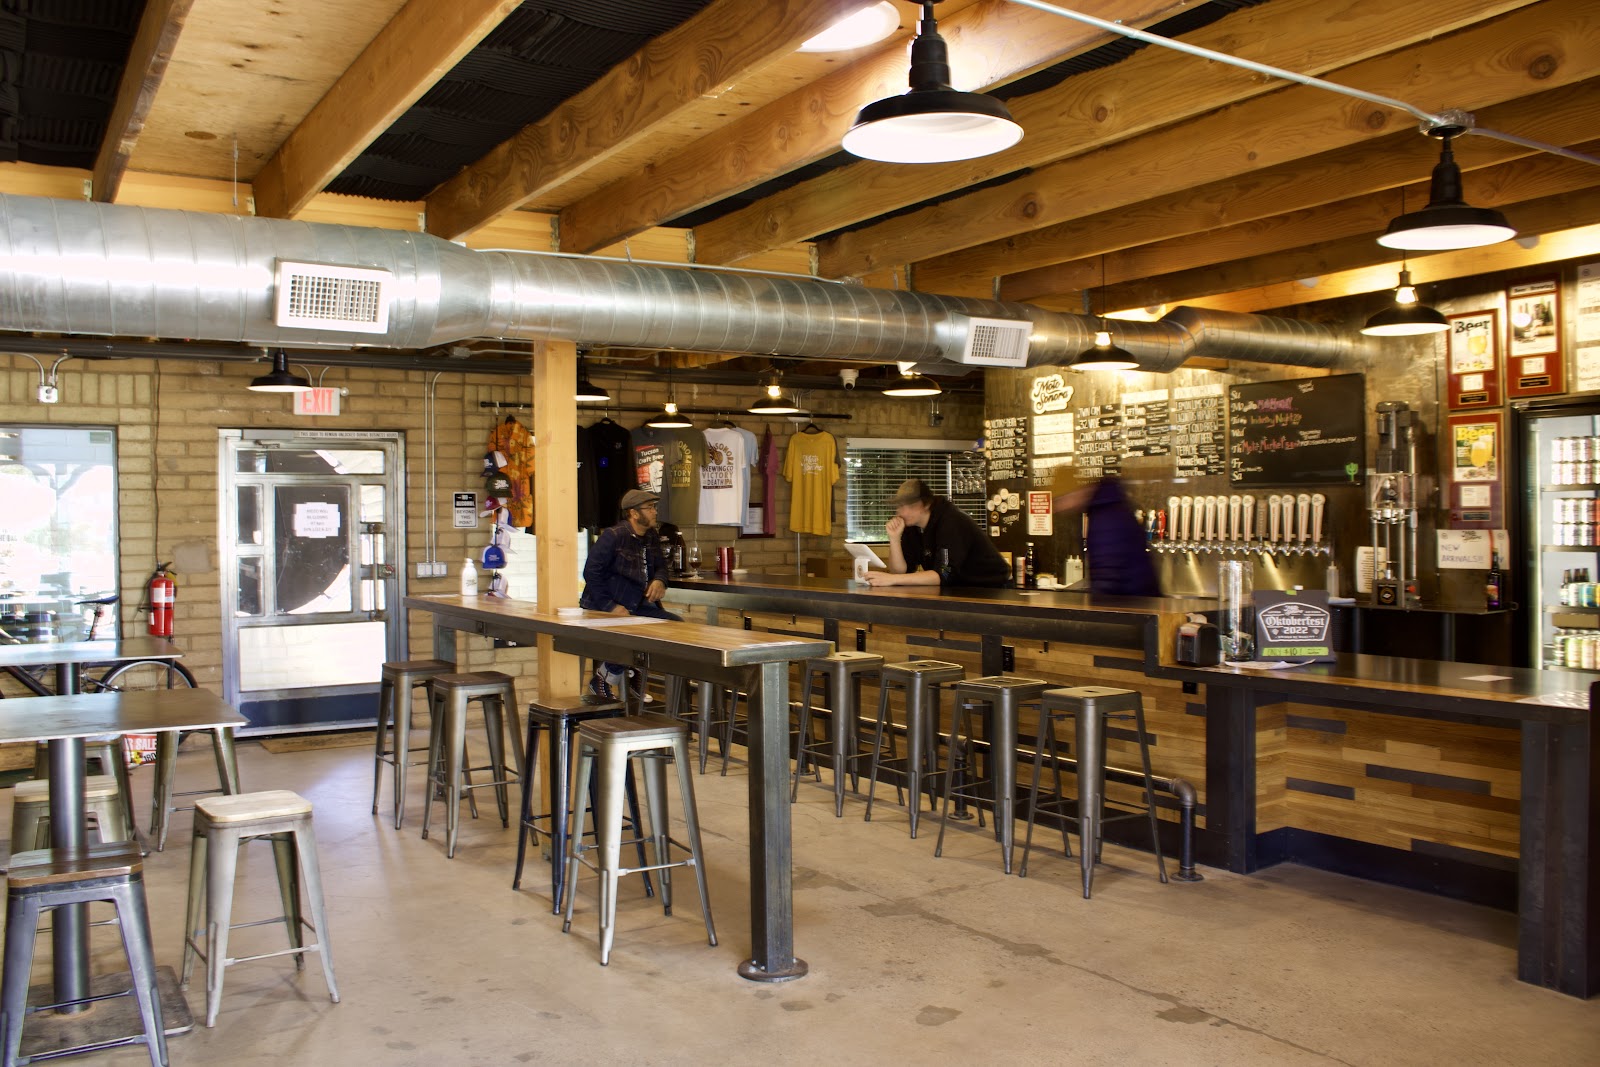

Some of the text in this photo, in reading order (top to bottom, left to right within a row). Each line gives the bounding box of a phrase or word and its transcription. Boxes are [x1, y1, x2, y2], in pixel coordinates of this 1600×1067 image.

[1454, 320, 1490, 334] Beer
[1034, 379, 1060, 397] Moto
[303, 387, 334, 413] EXIT
[1036, 390, 1068, 410] Sonora
[1457, 427, 1495, 441] Beer
[641, 448, 659, 457] Tucson
[715, 442, 734, 465] SONORA
[638, 456, 652, 464] Craft
[673, 470, 692, 478] TORY
[702, 471, 733, 479] VICTORY
[1231, 471, 1242, 481] Sa
[1265, 616, 1325, 626] Oktoberfest
[1283, 626, 1309, 634] 2022
[136, 738, 157, 750] SALE
